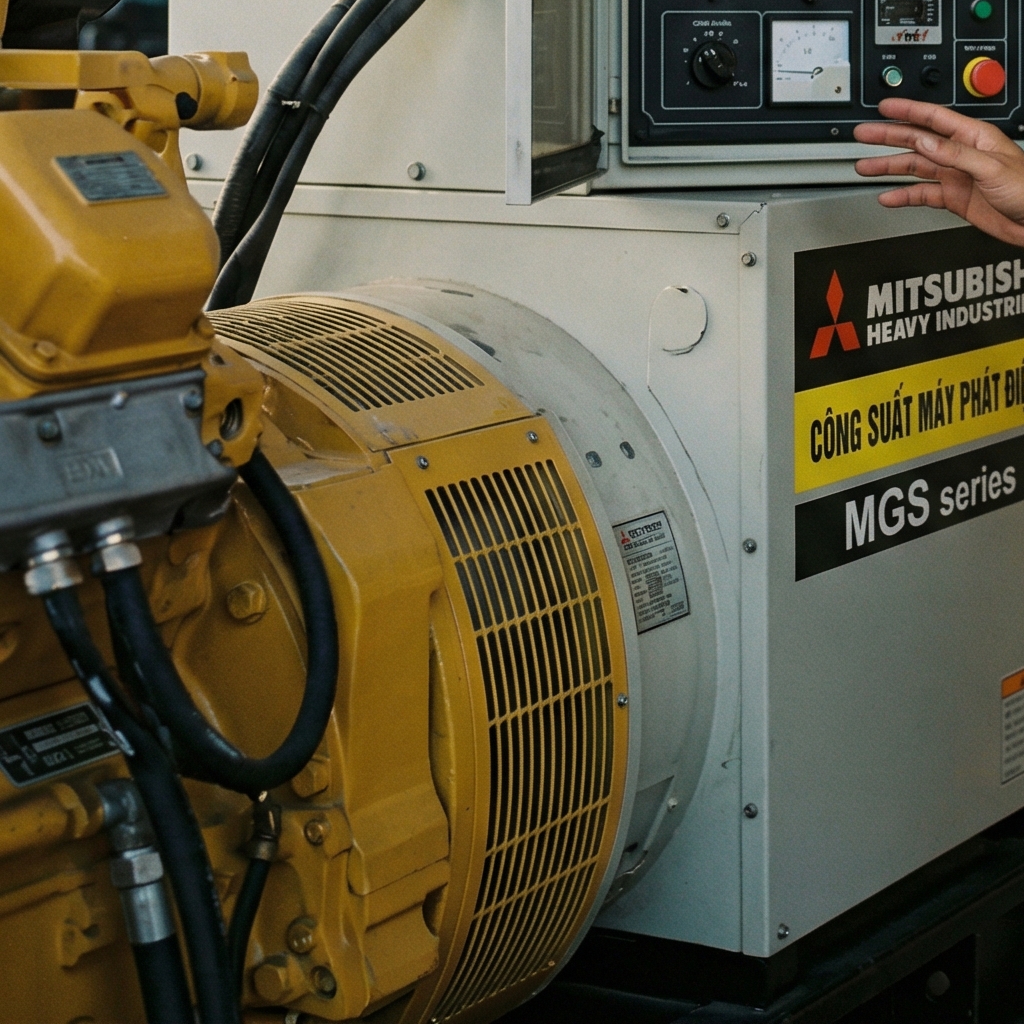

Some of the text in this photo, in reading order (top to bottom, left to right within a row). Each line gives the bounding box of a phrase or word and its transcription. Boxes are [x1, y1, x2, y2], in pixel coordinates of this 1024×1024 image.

[867, 314, 930, 347] HEAVY
[810, 407, 862, 463] CÔNG
[867, 382, 913, 447] SUẤT
[918, 378, 955, 433] MÁY
[960, 366, 1001, 421] PHÁT
[845, 465, 1016, 550] MGS series
